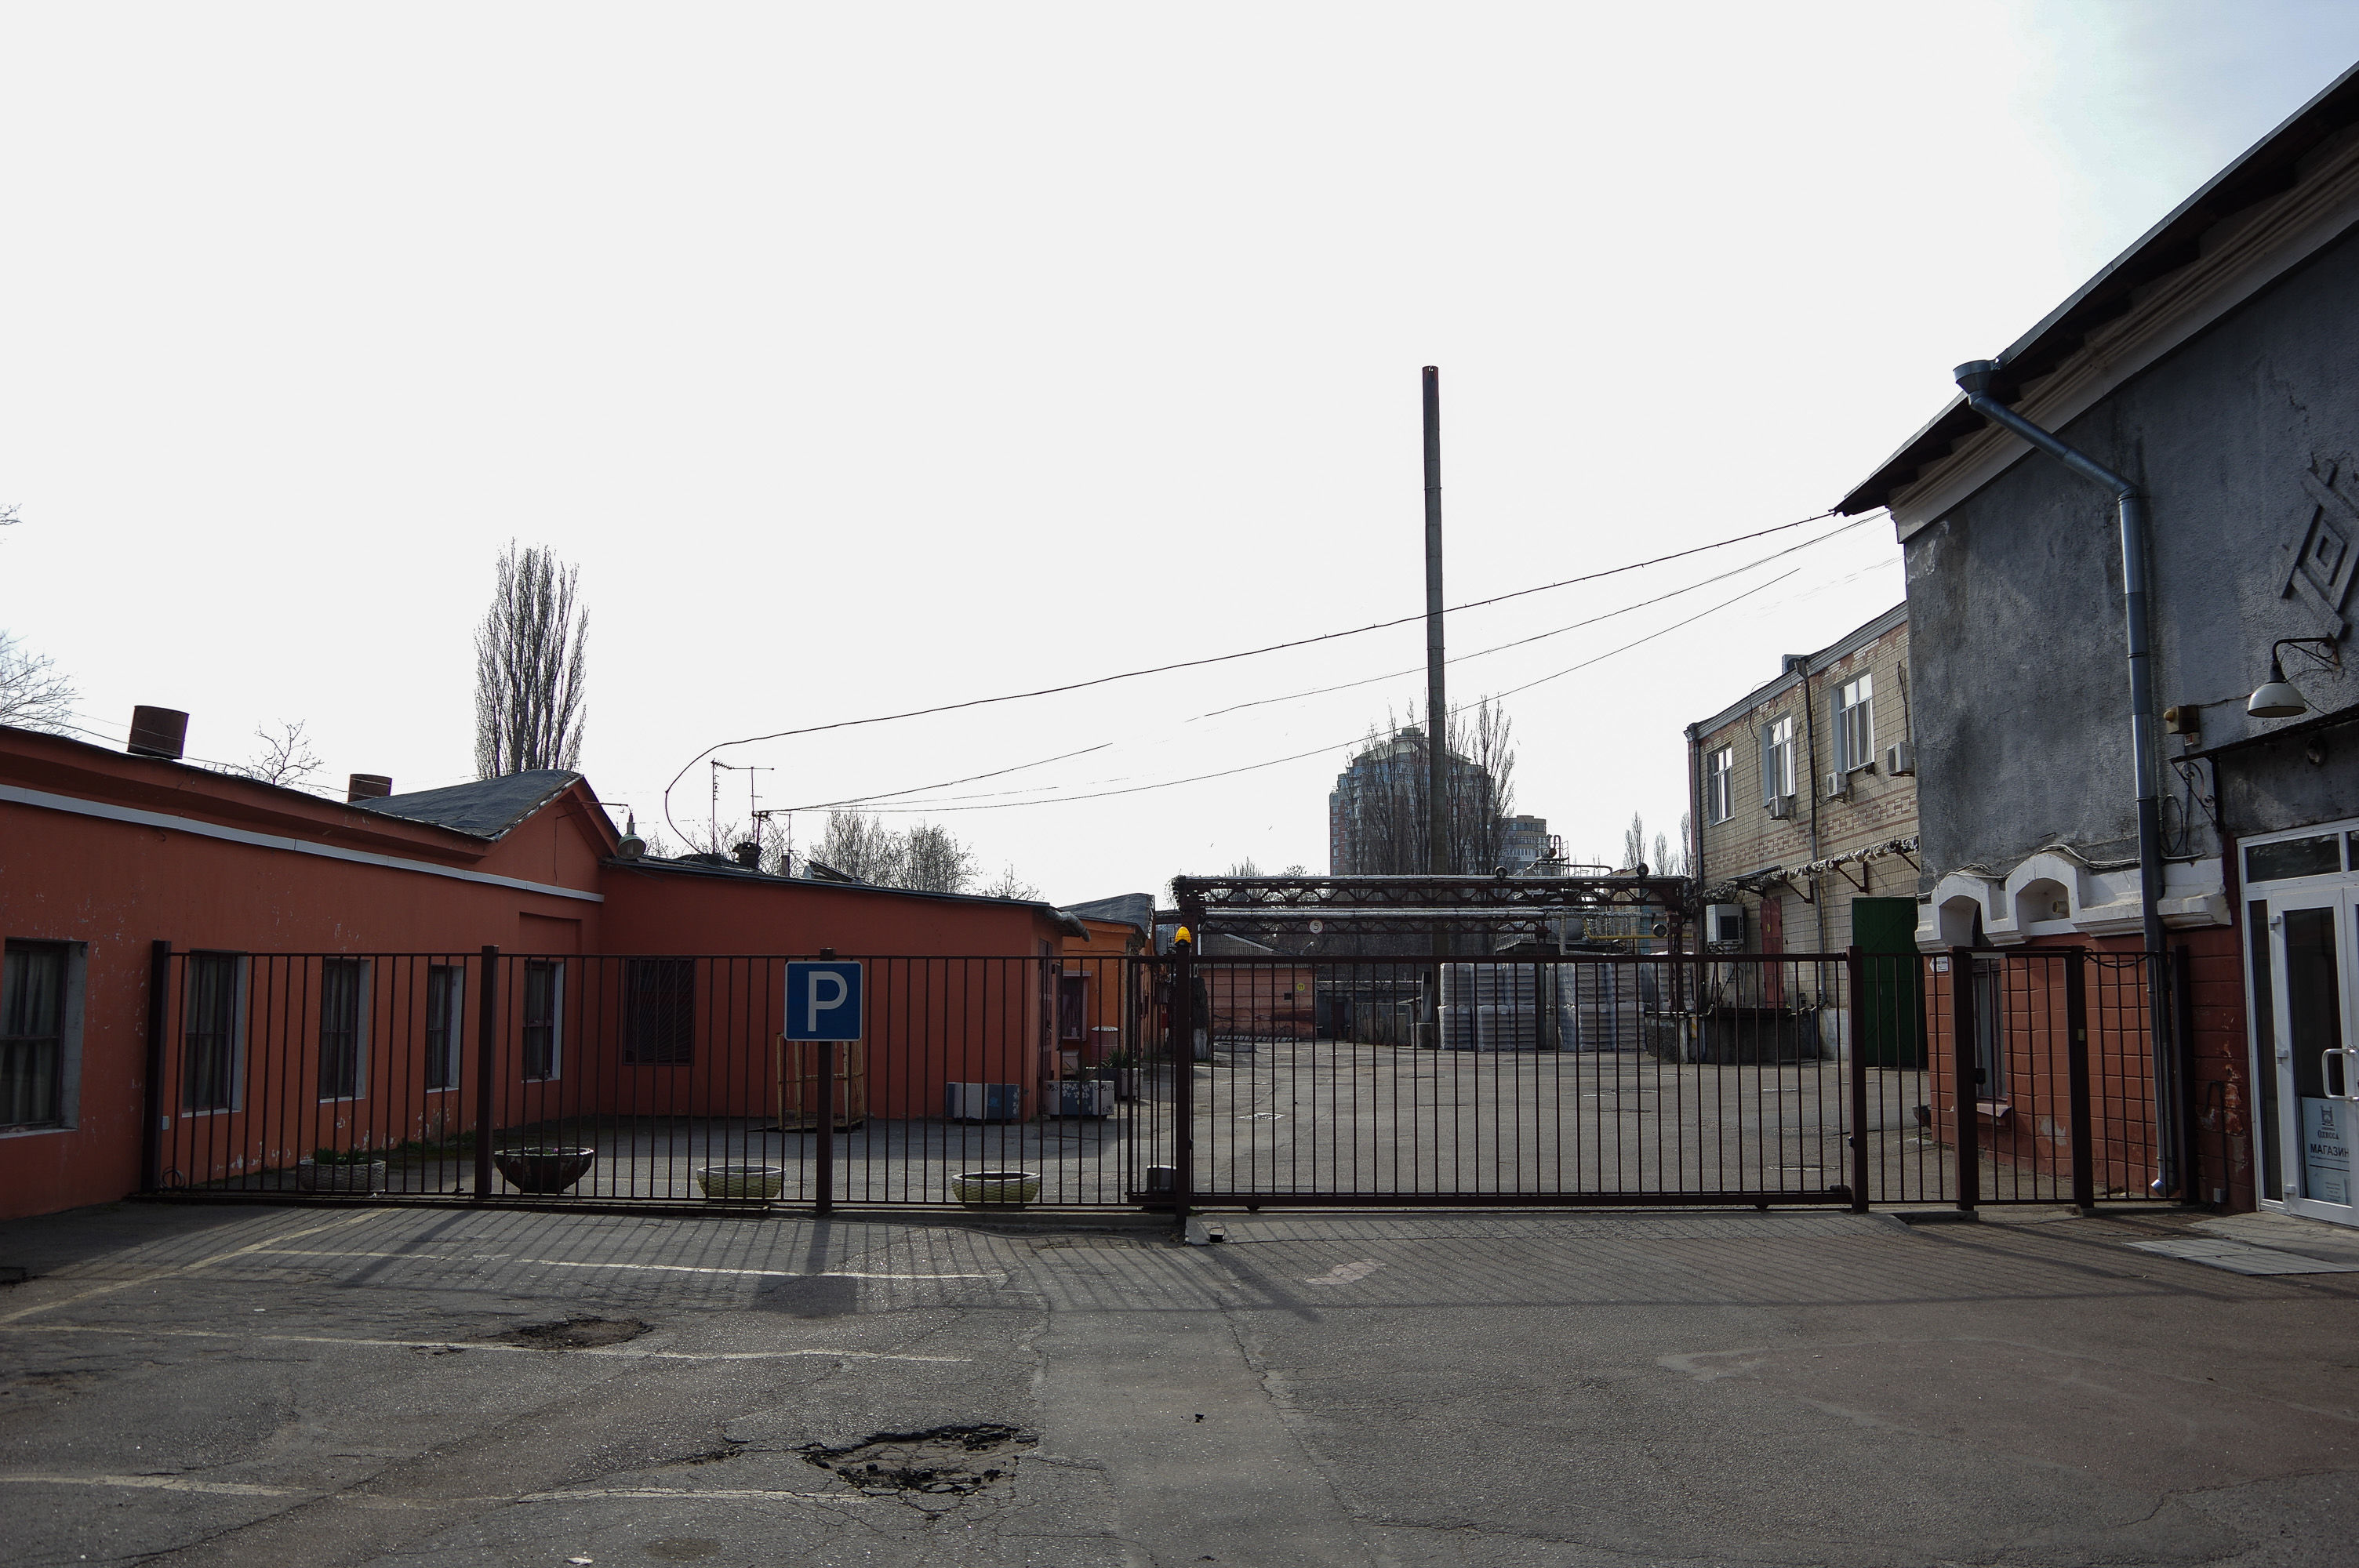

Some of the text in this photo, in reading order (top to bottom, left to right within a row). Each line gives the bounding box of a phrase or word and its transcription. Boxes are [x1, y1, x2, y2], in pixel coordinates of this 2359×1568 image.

[1314, 922, 1319, 931] 5
[808, 971, 847, 1031] P
[2310, 1144, 2350, 1158] МАГАЗИН
